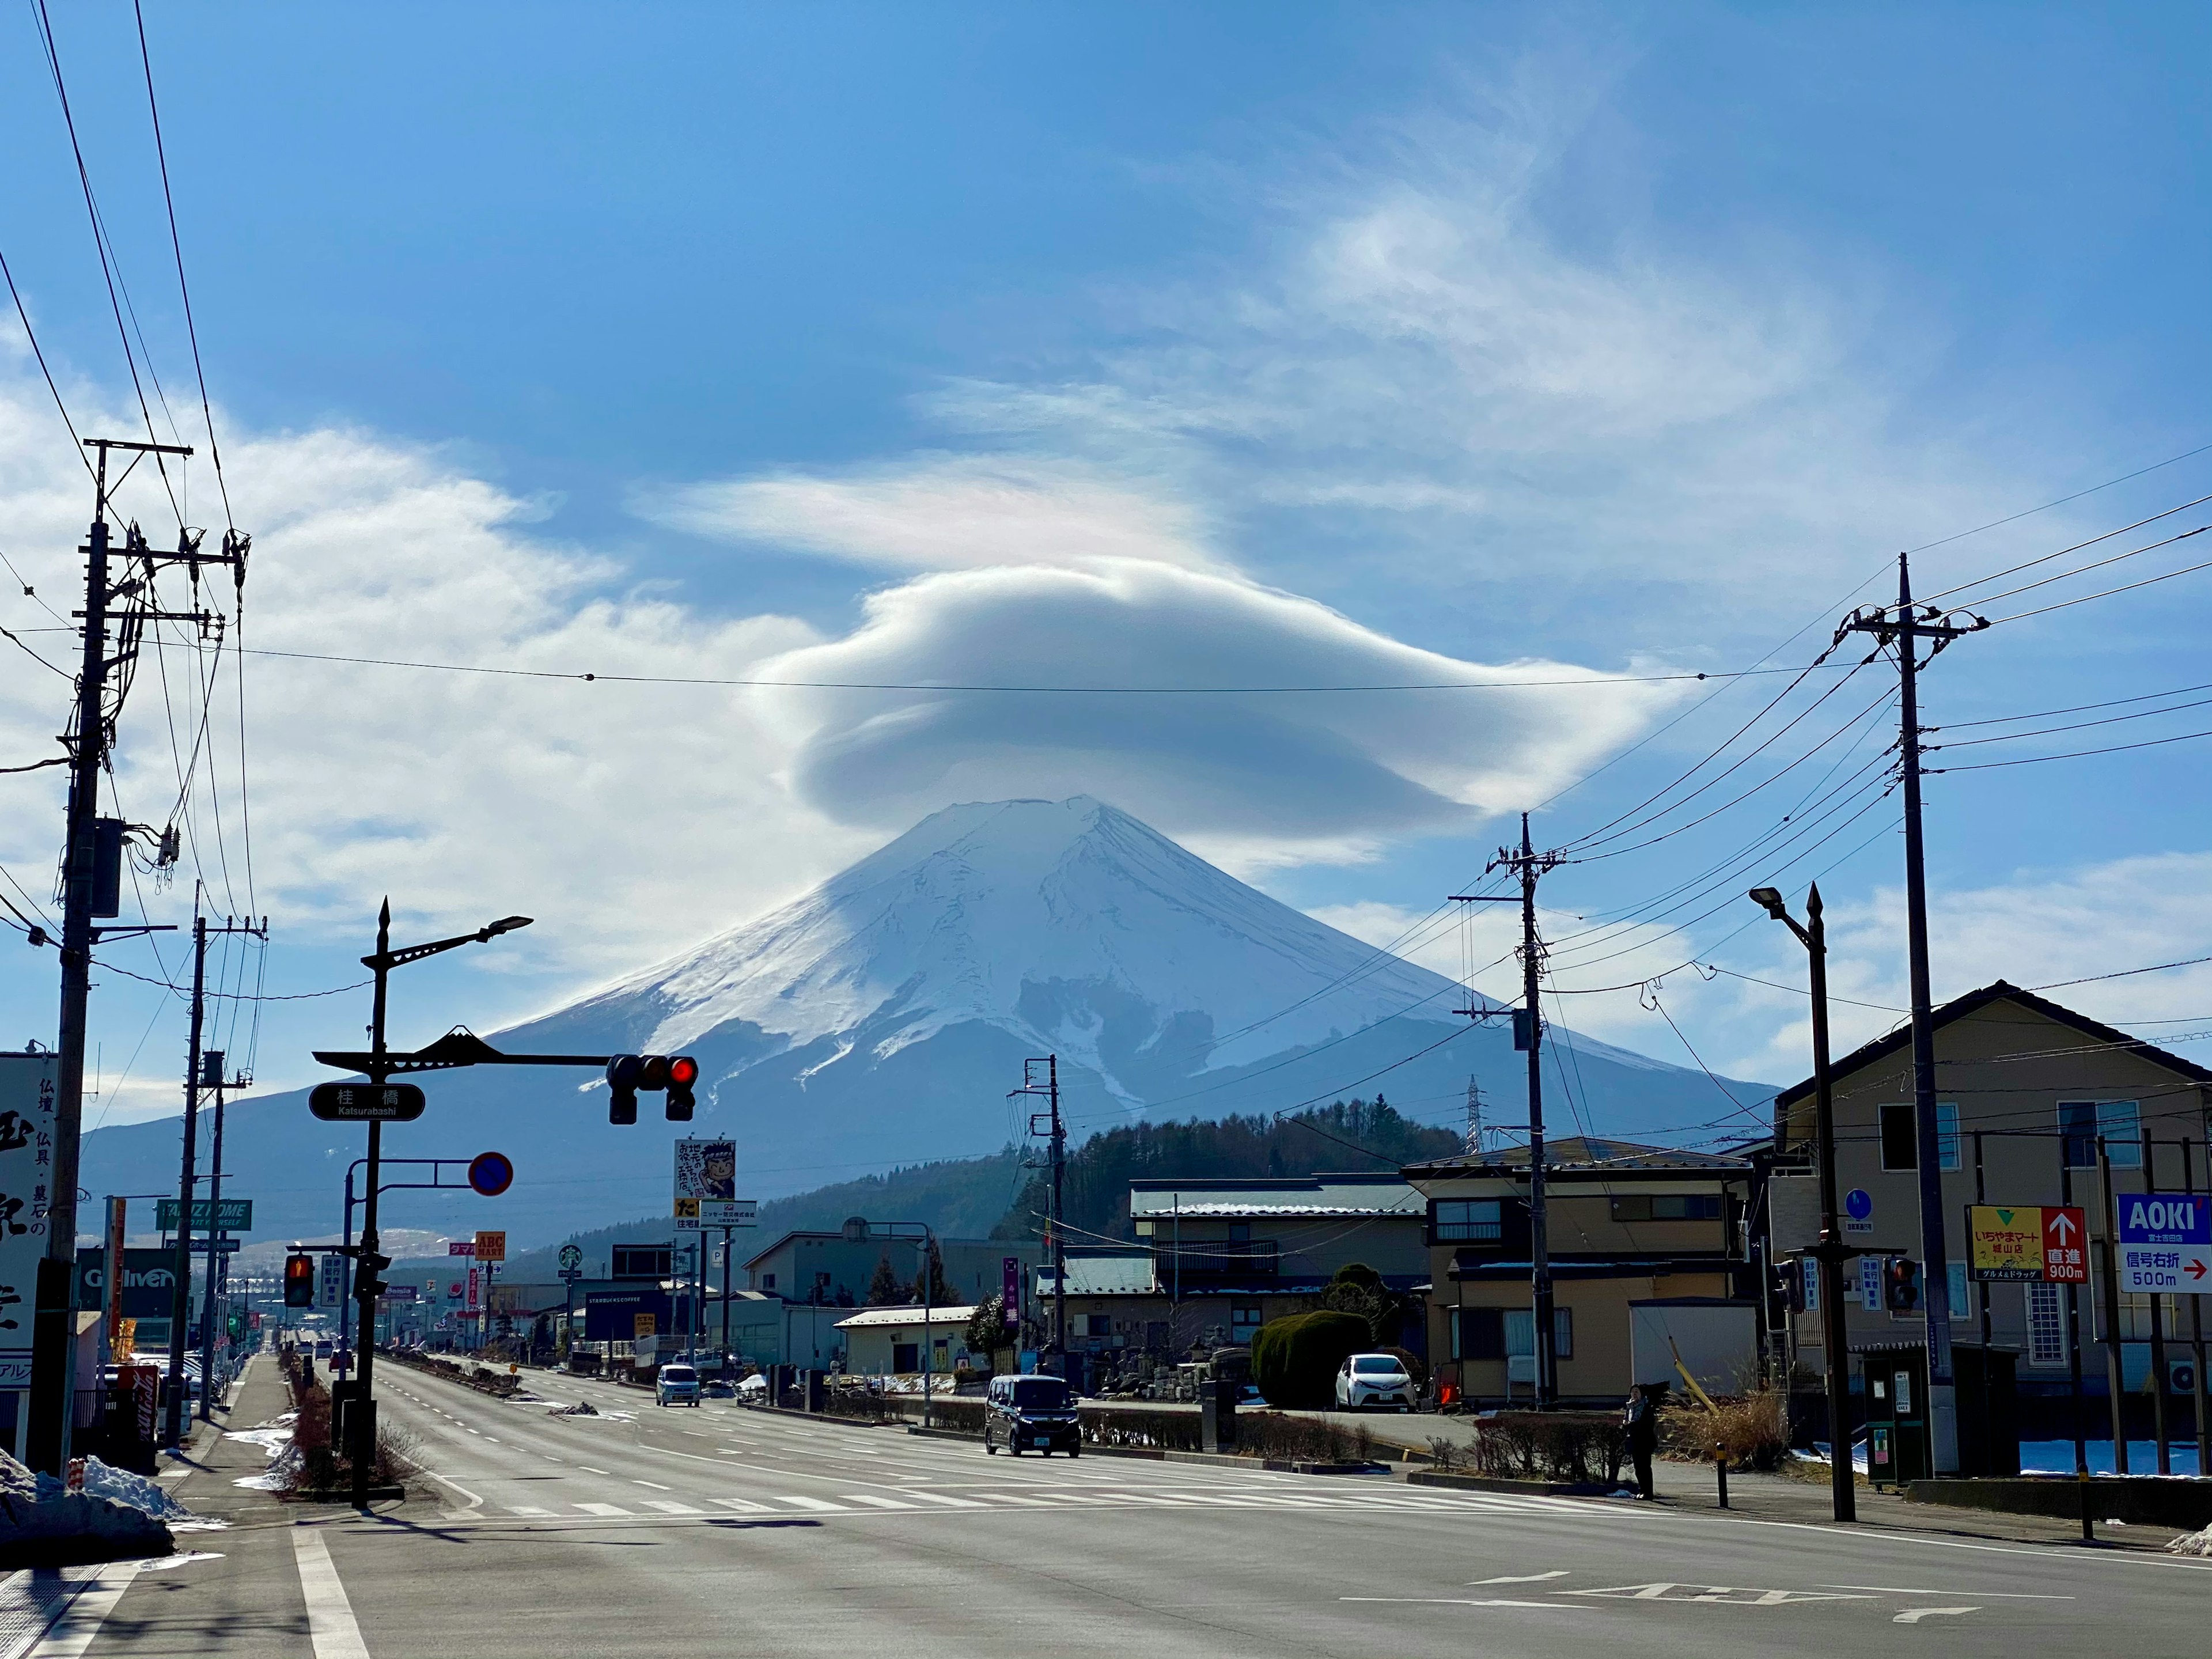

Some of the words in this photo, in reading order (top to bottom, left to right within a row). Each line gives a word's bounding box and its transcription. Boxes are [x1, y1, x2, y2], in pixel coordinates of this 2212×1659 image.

[338, 1107, 396, 1116] Katsurabashi
[31, 1078, 55, 1236] 仏壇・仏具・墓石の
[2128, 1201, 2195, 1230] AOKI
[478, 1236, 503, 1248] ABC
[1975, 1231, 2039, 1243] いちやまマート
[2147, 1234, 2183, 1242] 富士吉田店
[1993, 1244, 2023, 1253] 城山店
[715, 1252, 720, 1260] P
[2048, 1248, 2081, 1264] 直進
[2126, 1252, 2180, 1268] 信号右折
[85, 1268, 175, 1287] Gliver
[2050, 1265, 2083, 1279] 900m
[2133, 1272, 2176, 1286] 500m
